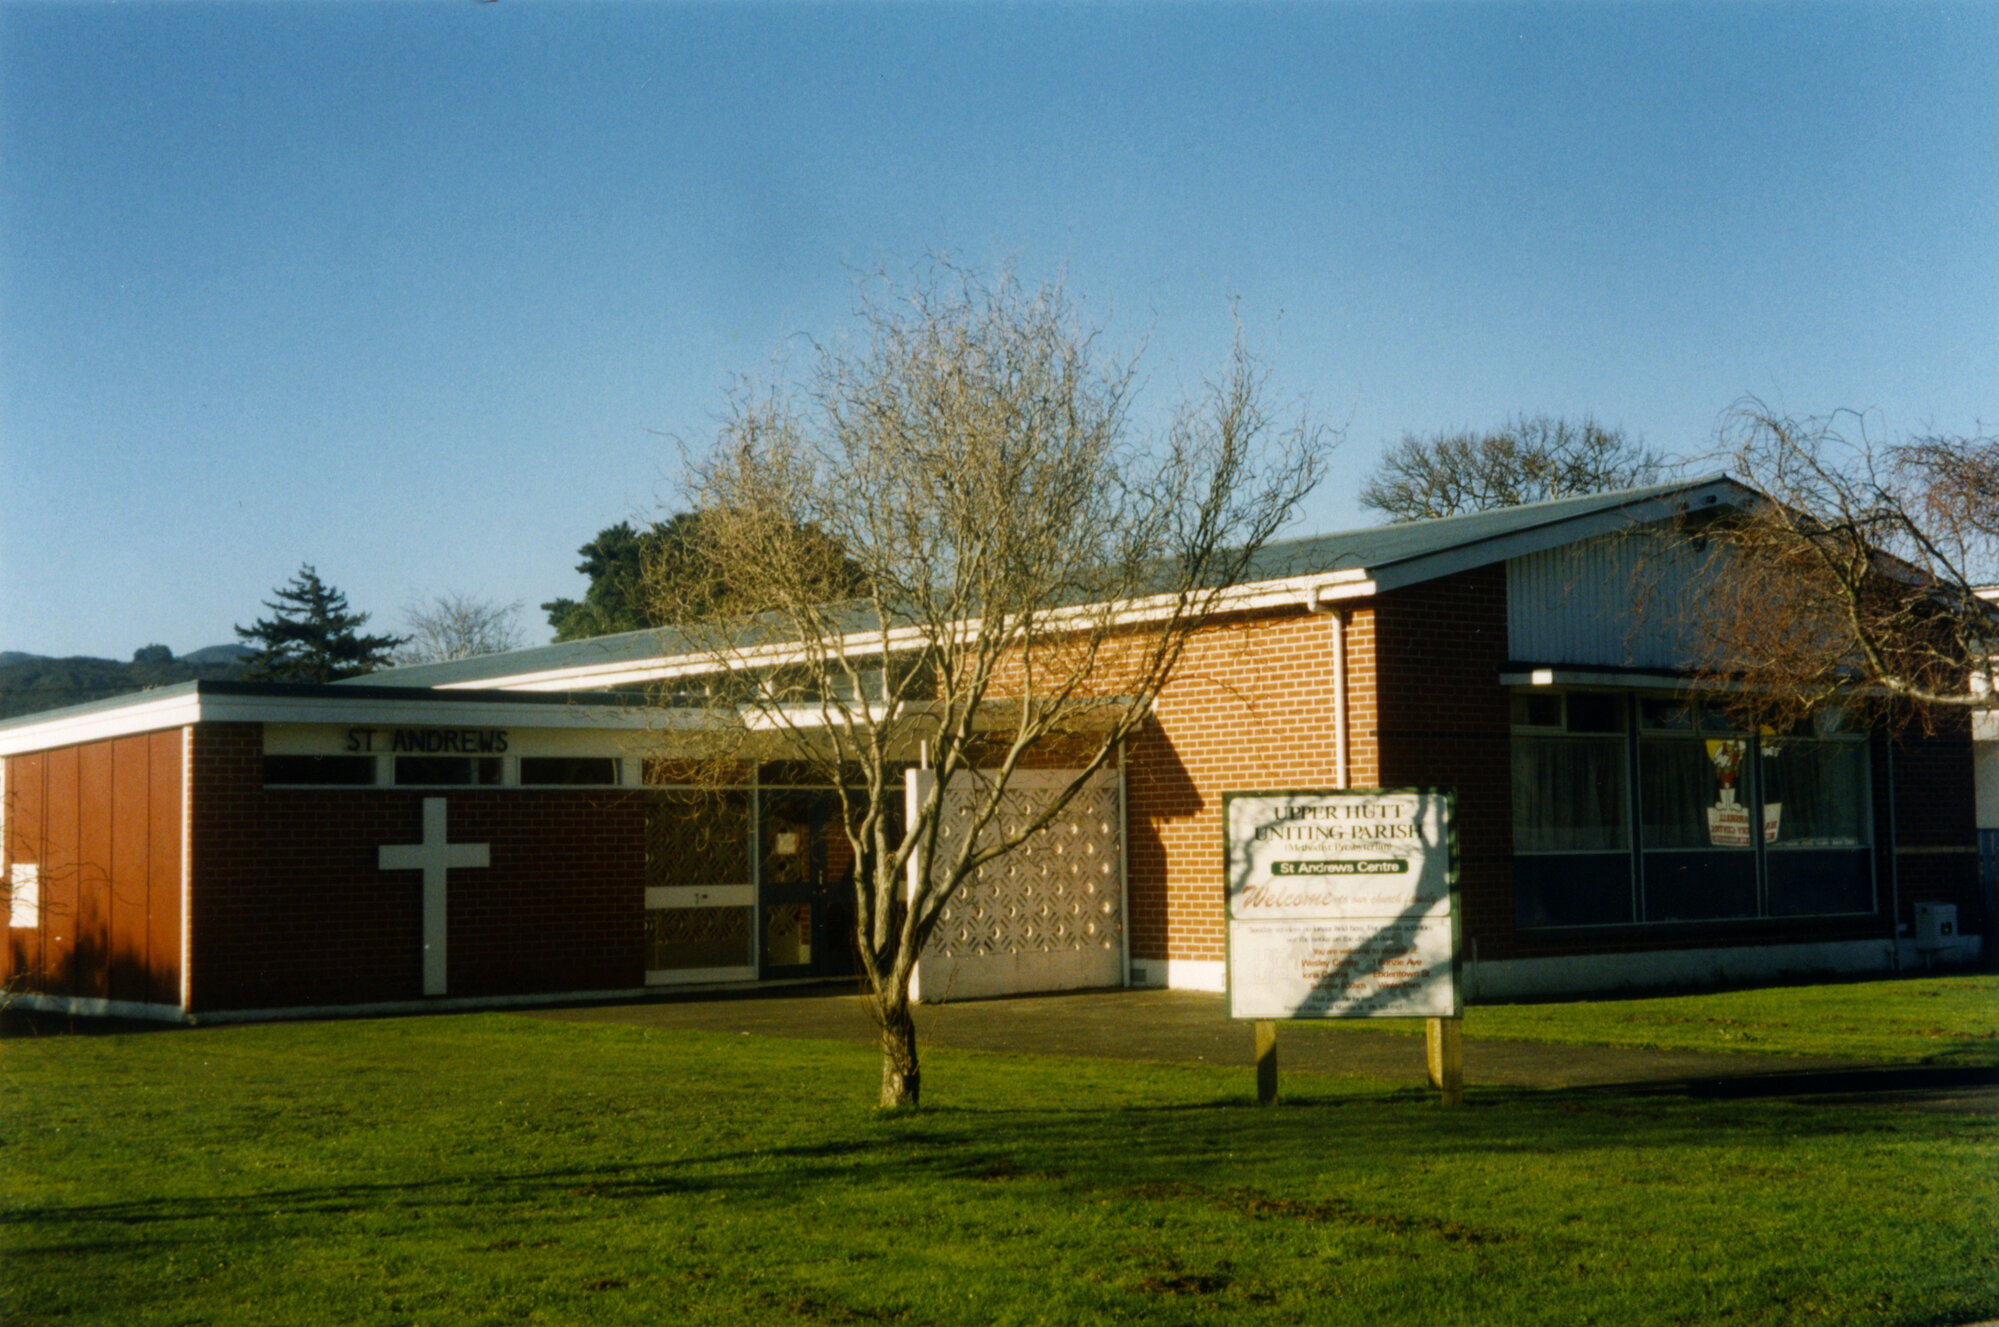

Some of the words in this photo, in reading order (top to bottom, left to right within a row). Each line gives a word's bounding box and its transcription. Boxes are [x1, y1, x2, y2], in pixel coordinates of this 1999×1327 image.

[346, 728, 378, 753] ST
[392, 729, 509, 753] ANDREWS
[1274, 805, 1339, 821] UPPER
[1345, 804, 1405, 819] HUTT
[1254, 825, 1345, 841] UNITING
[1351, 823, 1423, 840] PARISH
[1279, 862, 1296, 874] St
[1298, 861, 1354, 874] Andrews
[1357, 860, 1401, 873] Centre
[1241, 885, 1333, 909] Welcome
